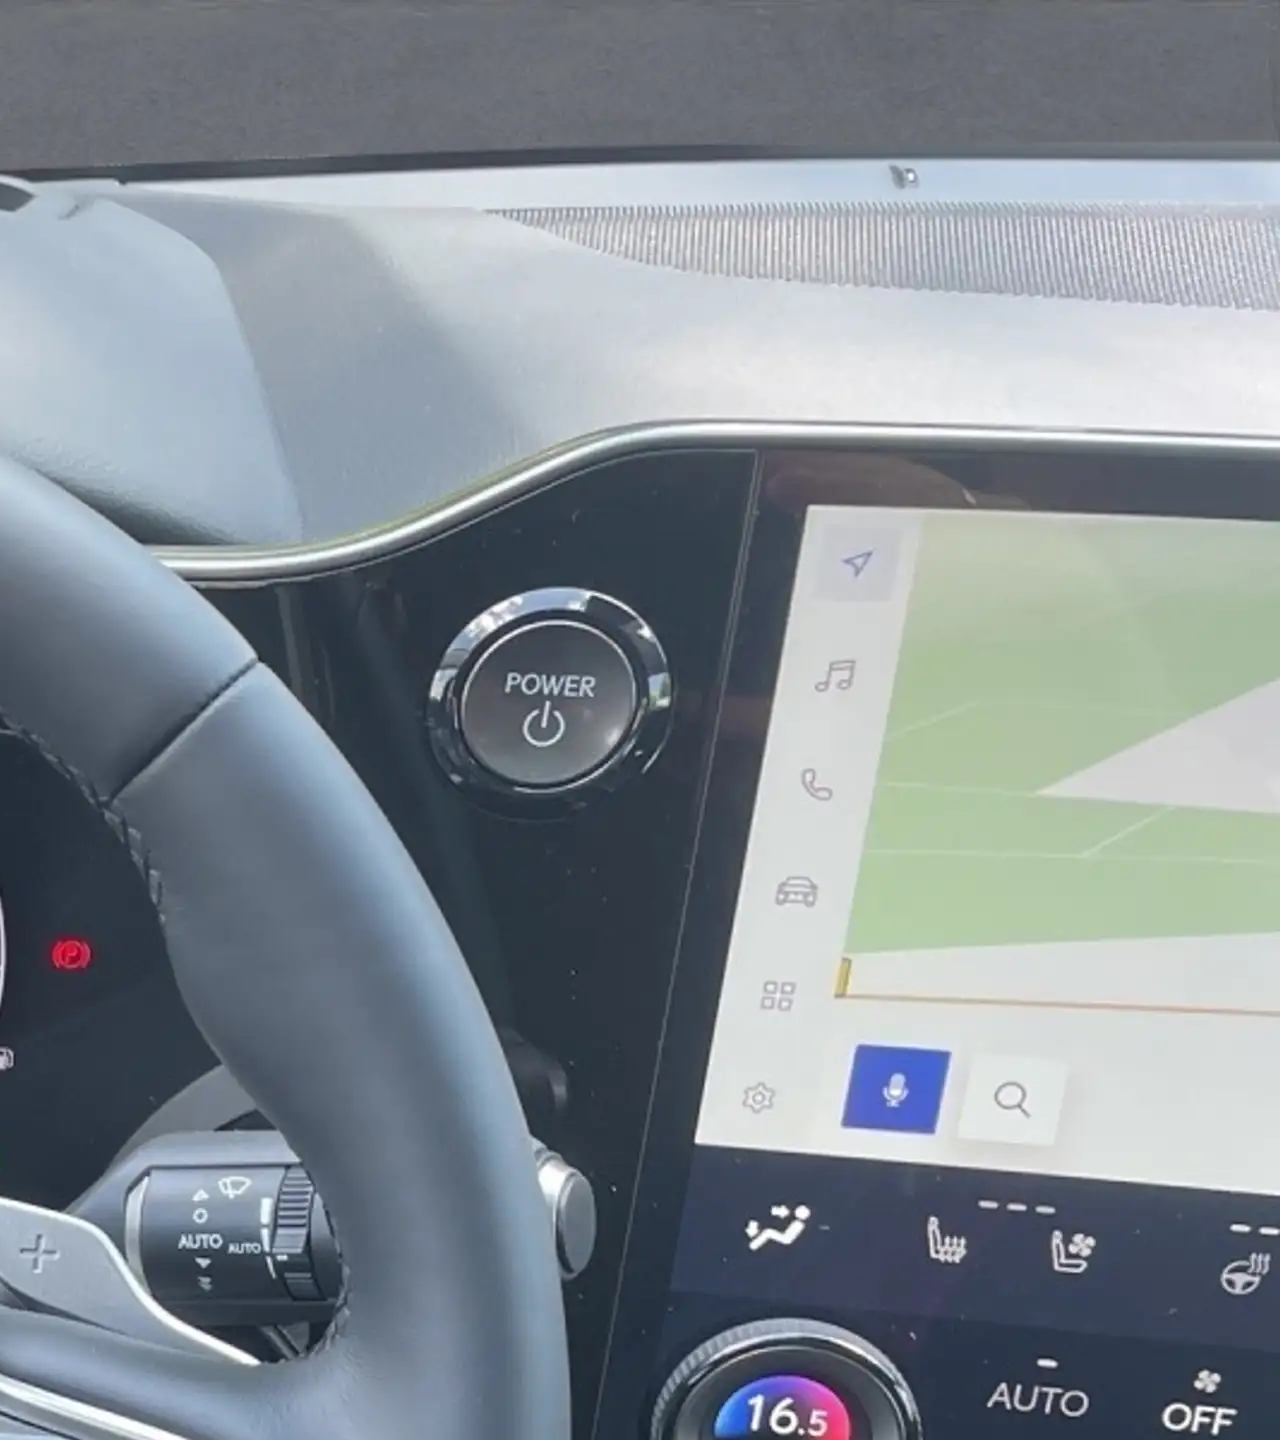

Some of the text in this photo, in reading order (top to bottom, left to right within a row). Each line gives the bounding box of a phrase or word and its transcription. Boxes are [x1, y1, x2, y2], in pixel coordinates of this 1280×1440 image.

[504, 671, 597, 698] POWER
[177, 1232, 224, 1250] AUTO
[227, 1241, 262, 1255] AUTO
[986, 1382, 1090, 1418] AUTO
[746, 1394, 828, 1438] 16.5
[1161, 1402, 1238, 1436] OFF
